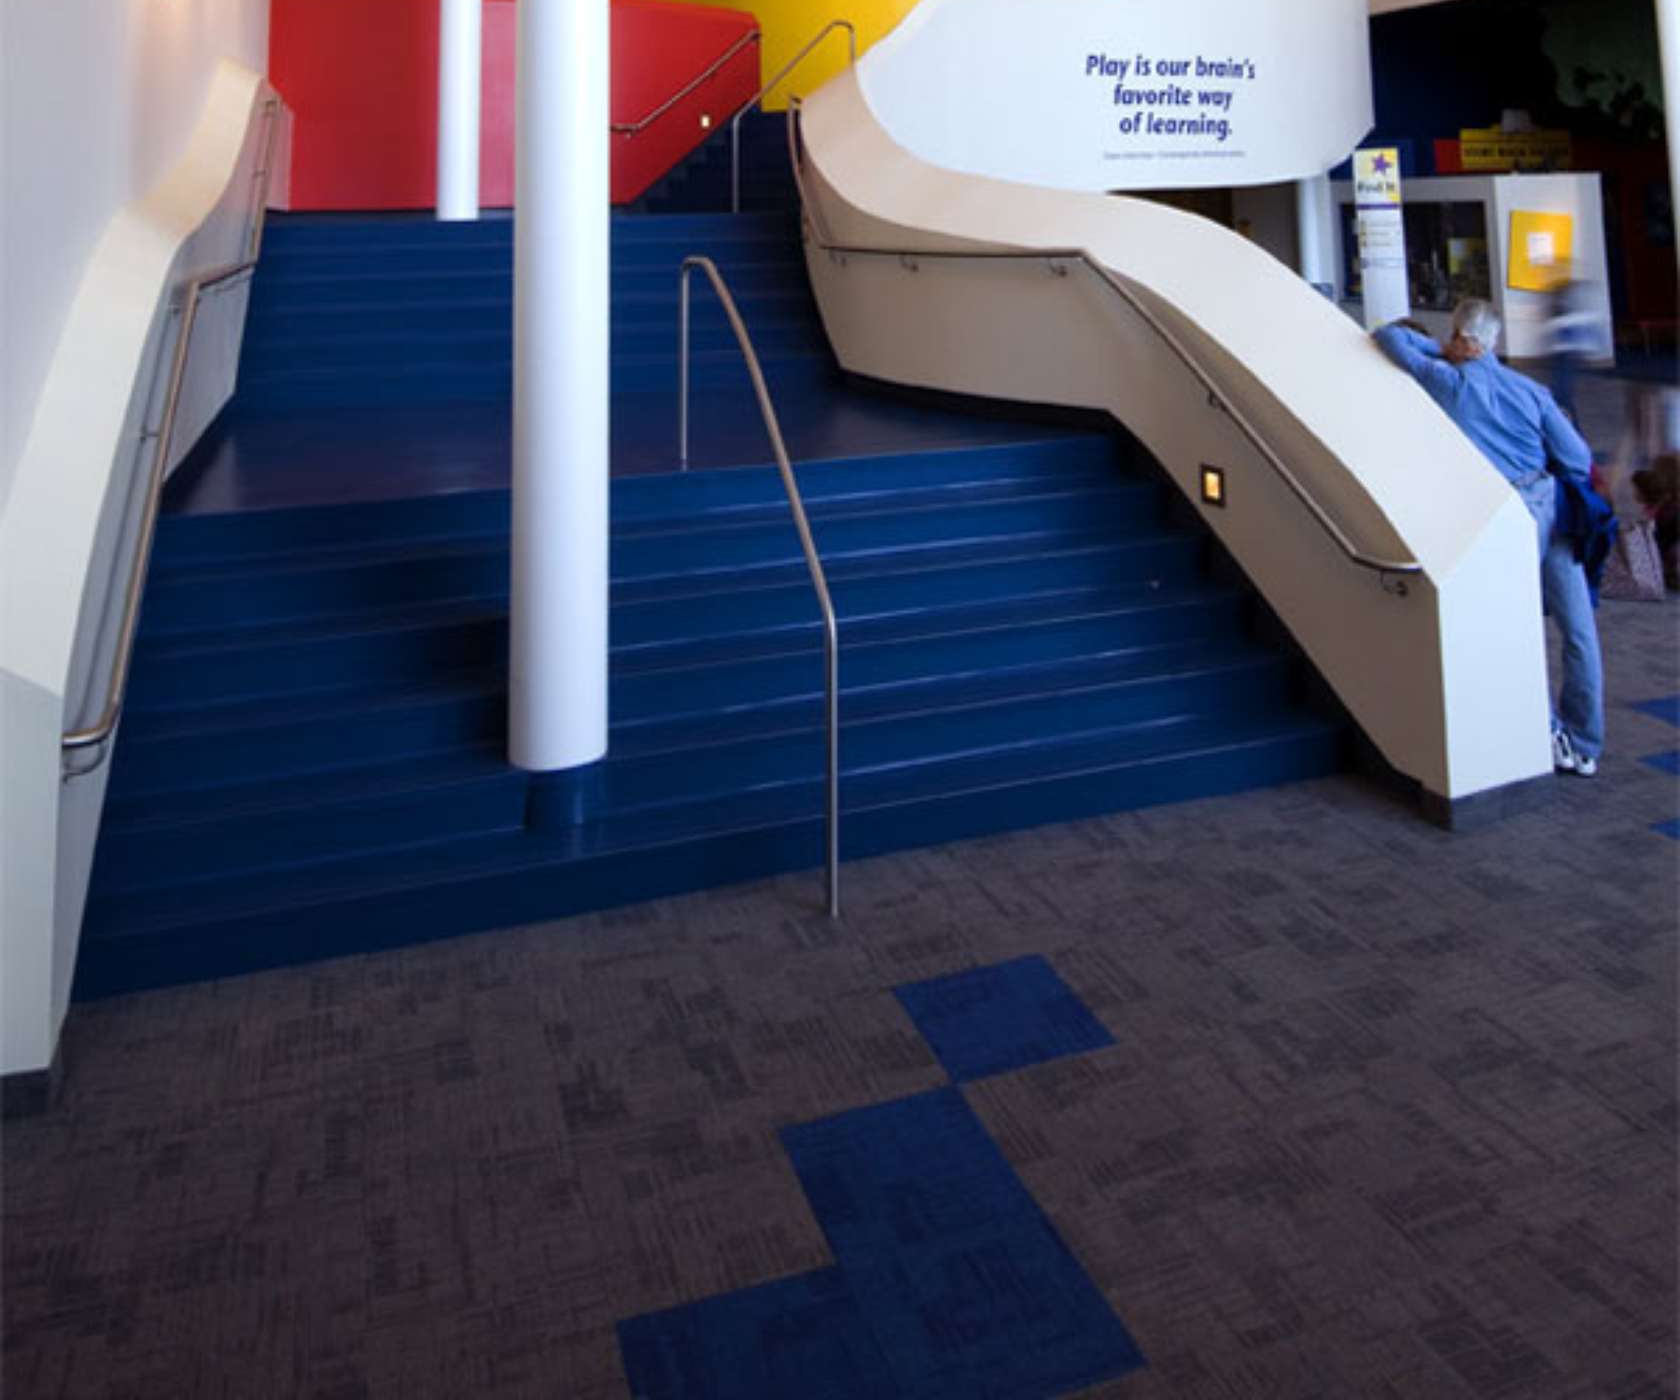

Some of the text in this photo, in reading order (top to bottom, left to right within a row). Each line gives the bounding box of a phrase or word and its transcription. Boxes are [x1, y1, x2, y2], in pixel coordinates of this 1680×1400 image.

[1086, 54, 1256, 79] Play is our brain's
[1113, 83, 1233, 111] favorite way
[1119, 111, 1233, 141] of learning.
